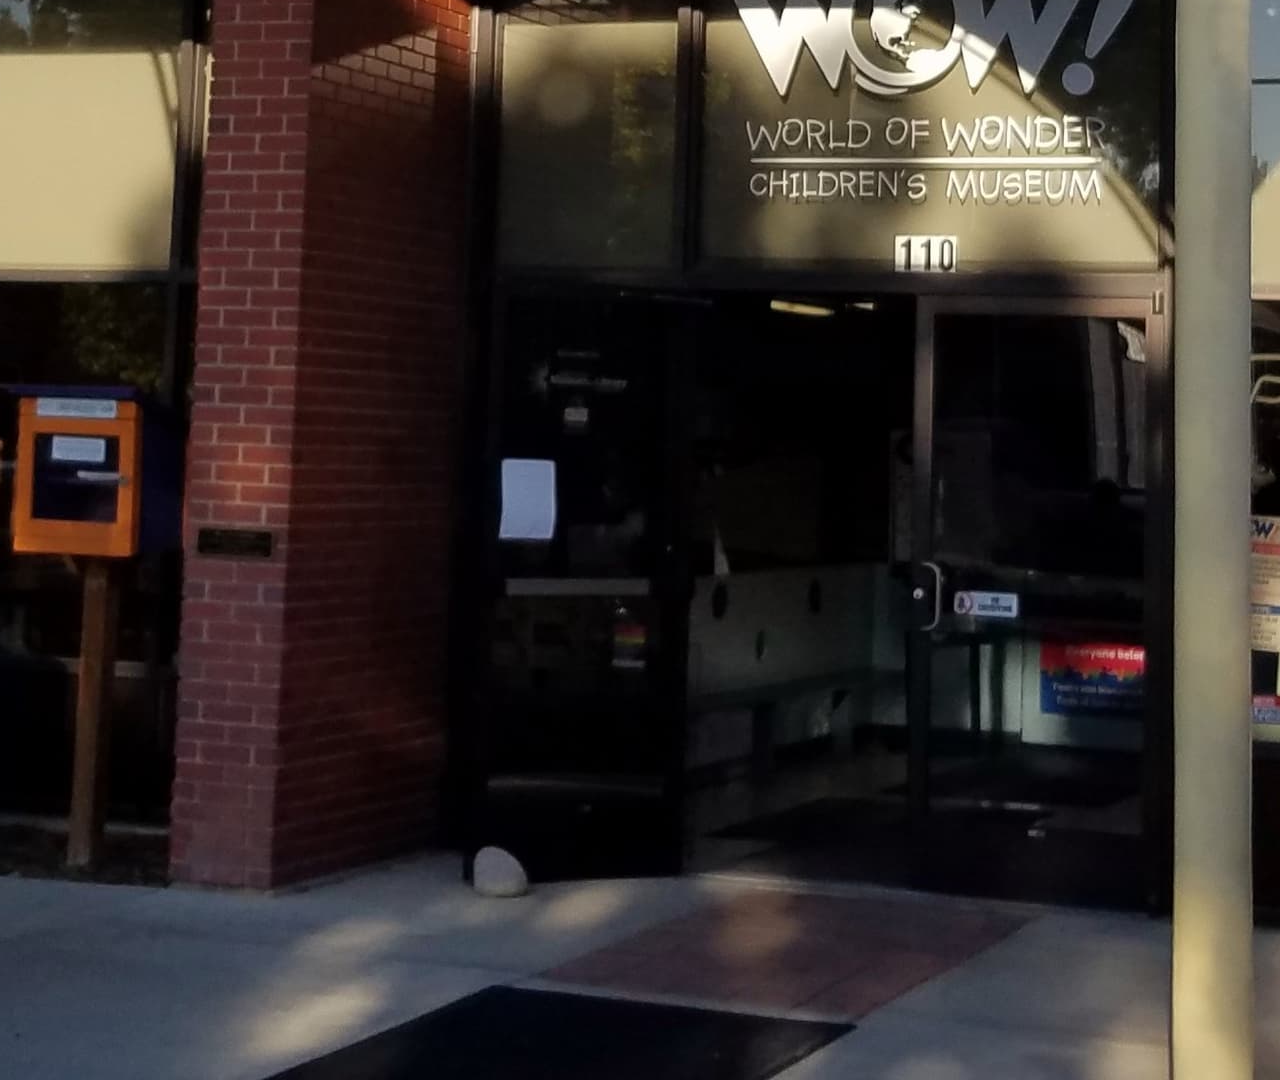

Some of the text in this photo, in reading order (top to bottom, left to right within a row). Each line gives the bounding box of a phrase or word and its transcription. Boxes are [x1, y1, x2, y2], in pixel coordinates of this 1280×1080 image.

[746, 115, 1106, 152] WORLD OF WONDER
[749, 169, 1101, 200] CHILDREN'S MUSEUM
[900, 237, 954, 271] 110
